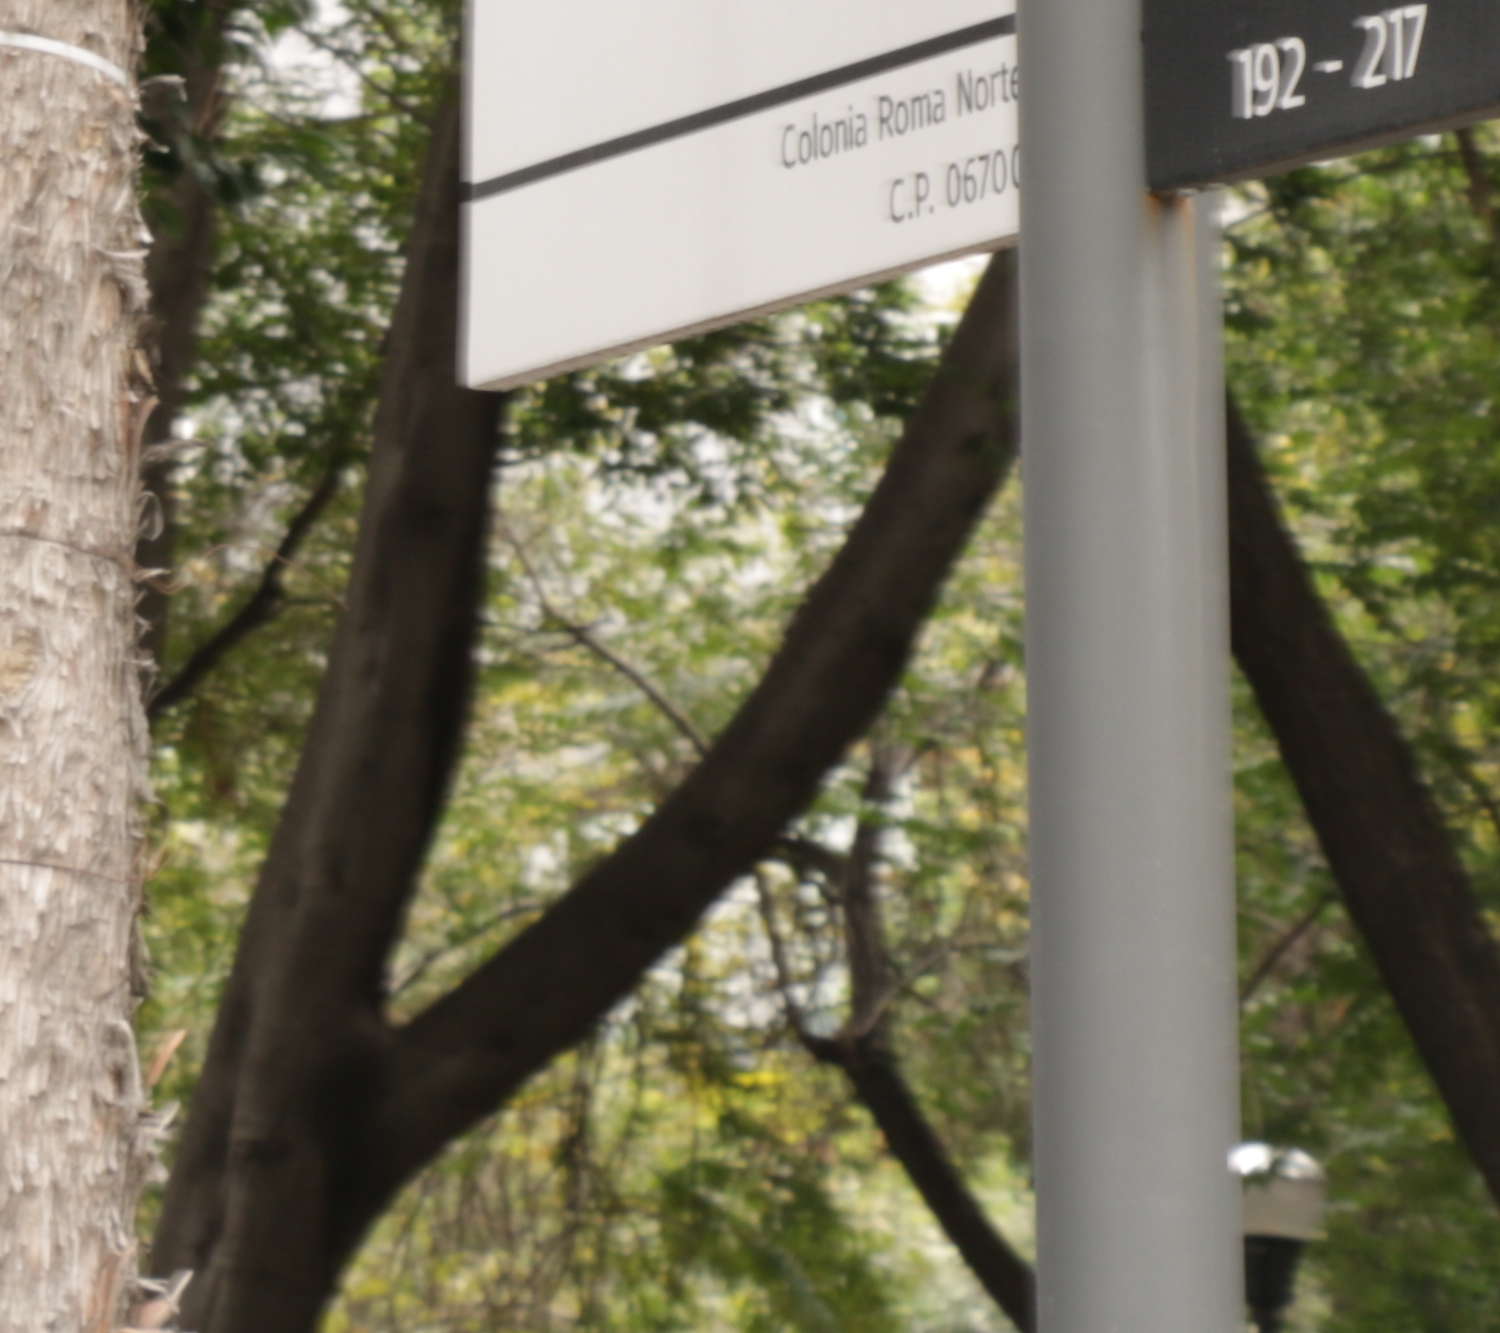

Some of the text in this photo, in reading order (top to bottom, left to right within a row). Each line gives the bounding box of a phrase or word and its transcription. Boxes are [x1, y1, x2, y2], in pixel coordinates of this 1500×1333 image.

[1227, 36, 1307, 119] 192
[1352, 4, 1428, 89] 217
[780, 104, 868, 169] Colonia
[877, 88, 946, 141] Roma
[889, 171, 935, 223] C.P.
